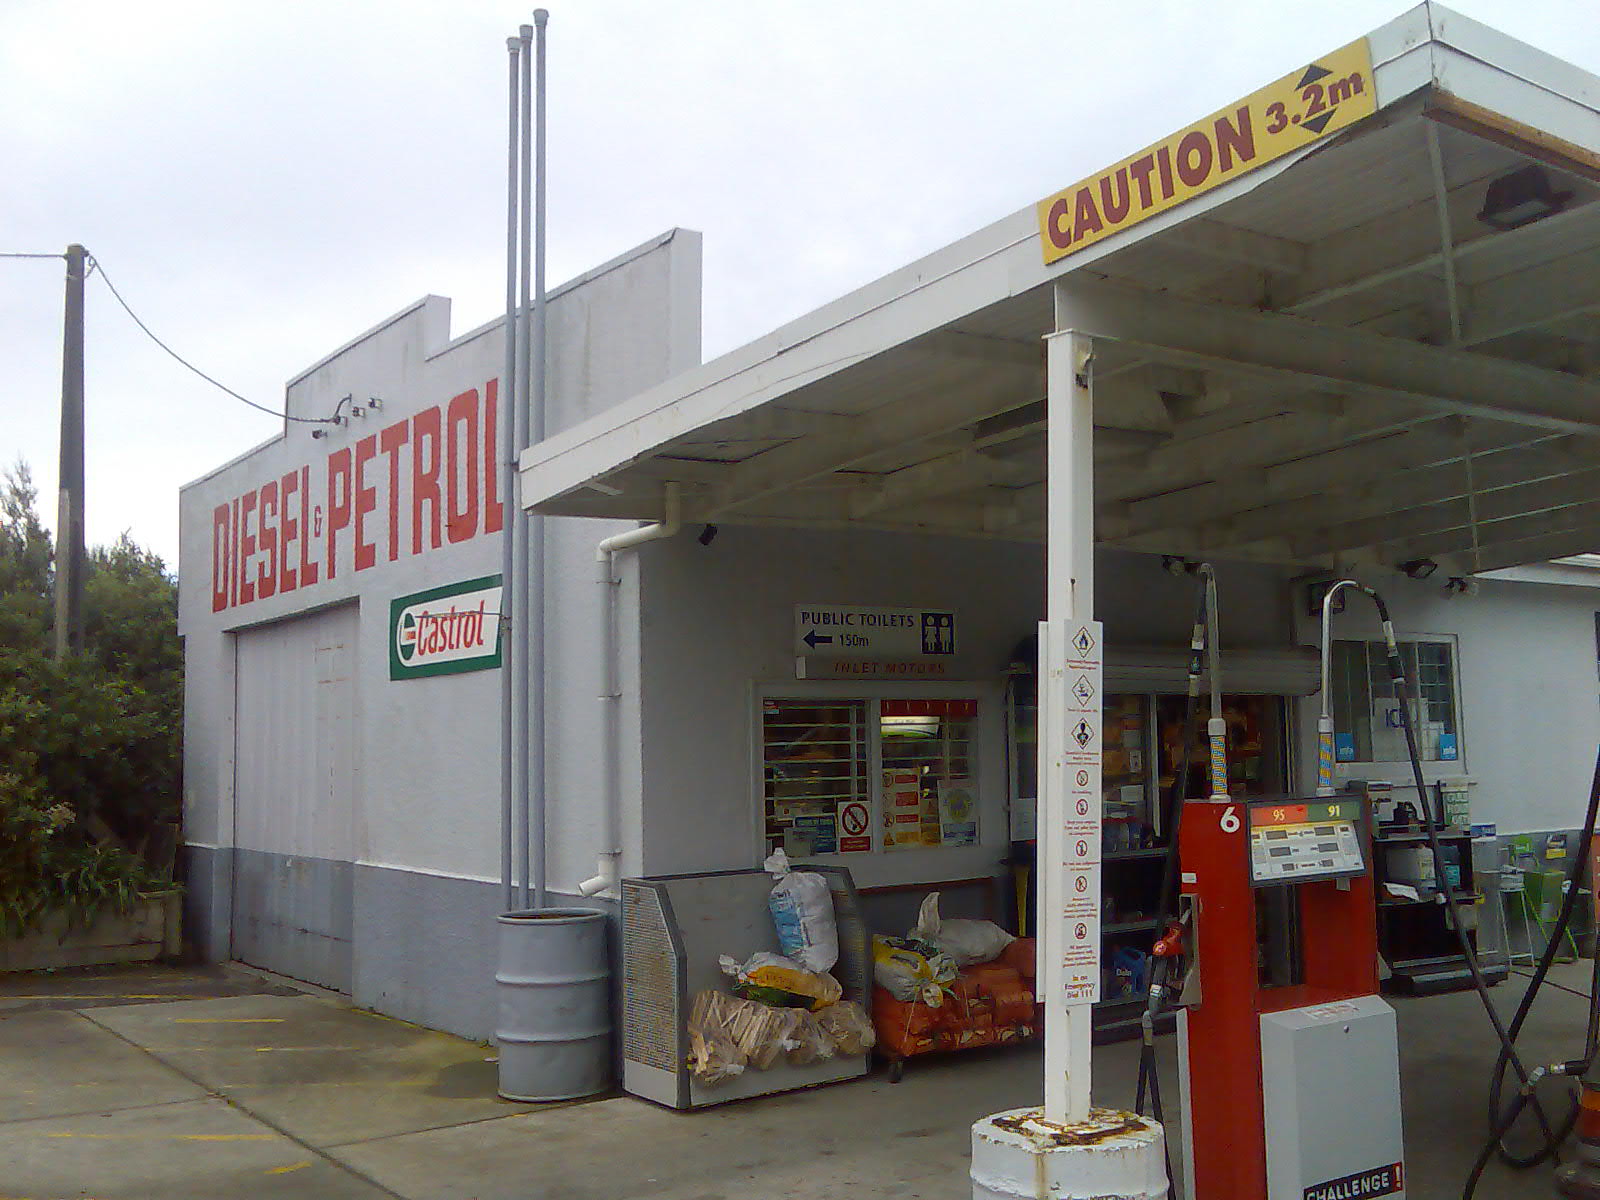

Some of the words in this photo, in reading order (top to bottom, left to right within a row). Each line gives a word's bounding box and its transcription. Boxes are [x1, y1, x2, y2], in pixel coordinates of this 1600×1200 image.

[1047, 104, 1256, 250] CAUTION
[1265, 71, 1366, 135] 3.2m
[212, 464, 319, 614] DIESEL
[326, 377, 504, 580] PETROL
[800, 611, 854, 626] PUBLIC
[860, 613, 915, 628] TOILETS
[416, 600, 485, 657] Castrol
[839, 633, 870, 649] 150m
[833, 661, 880, 674] INLET
[1219, 805, 1241, 834] 6
[1272, 808, 1286, 822] 95
[1327, 805, 1341, 818] 91
